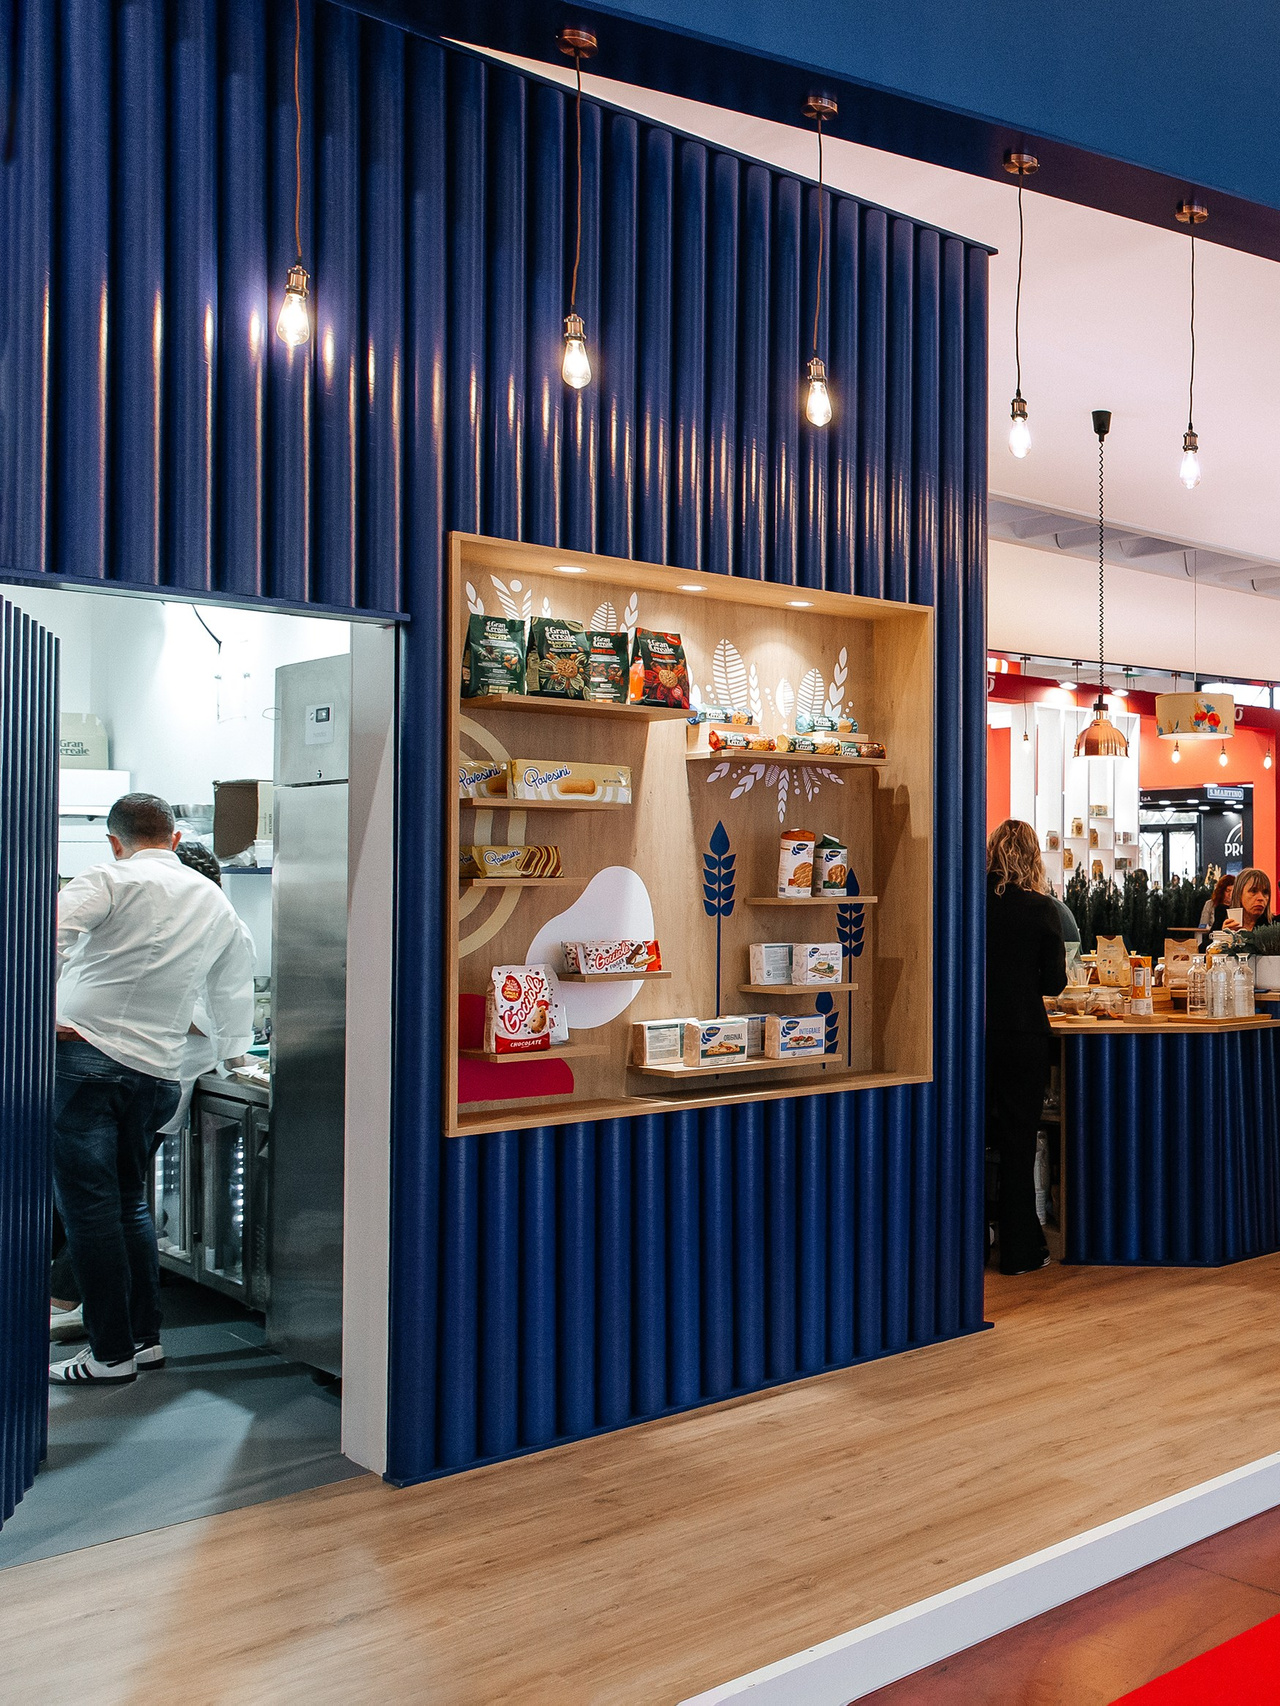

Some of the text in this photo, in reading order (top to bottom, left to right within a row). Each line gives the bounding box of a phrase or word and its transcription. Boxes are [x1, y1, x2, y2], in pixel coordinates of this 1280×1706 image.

[549, 627, 570, 635] Gran
[59, 739, 84, 748] Gran
[59, 746, 90, 756] ereale
[524, 764, 572, 789] Pavesini
[484, 849, 521, 866] Pavesini
[595, 942, 631, 970] Gocciole
[502, 974, 544, 1034] Gocciole
[798, 1026, 821, 1036] INTEGRALE
[723, 1032, 744, 1042] ORIGINAL
[510, 1038, 542, 1048] CHOCOLATE
